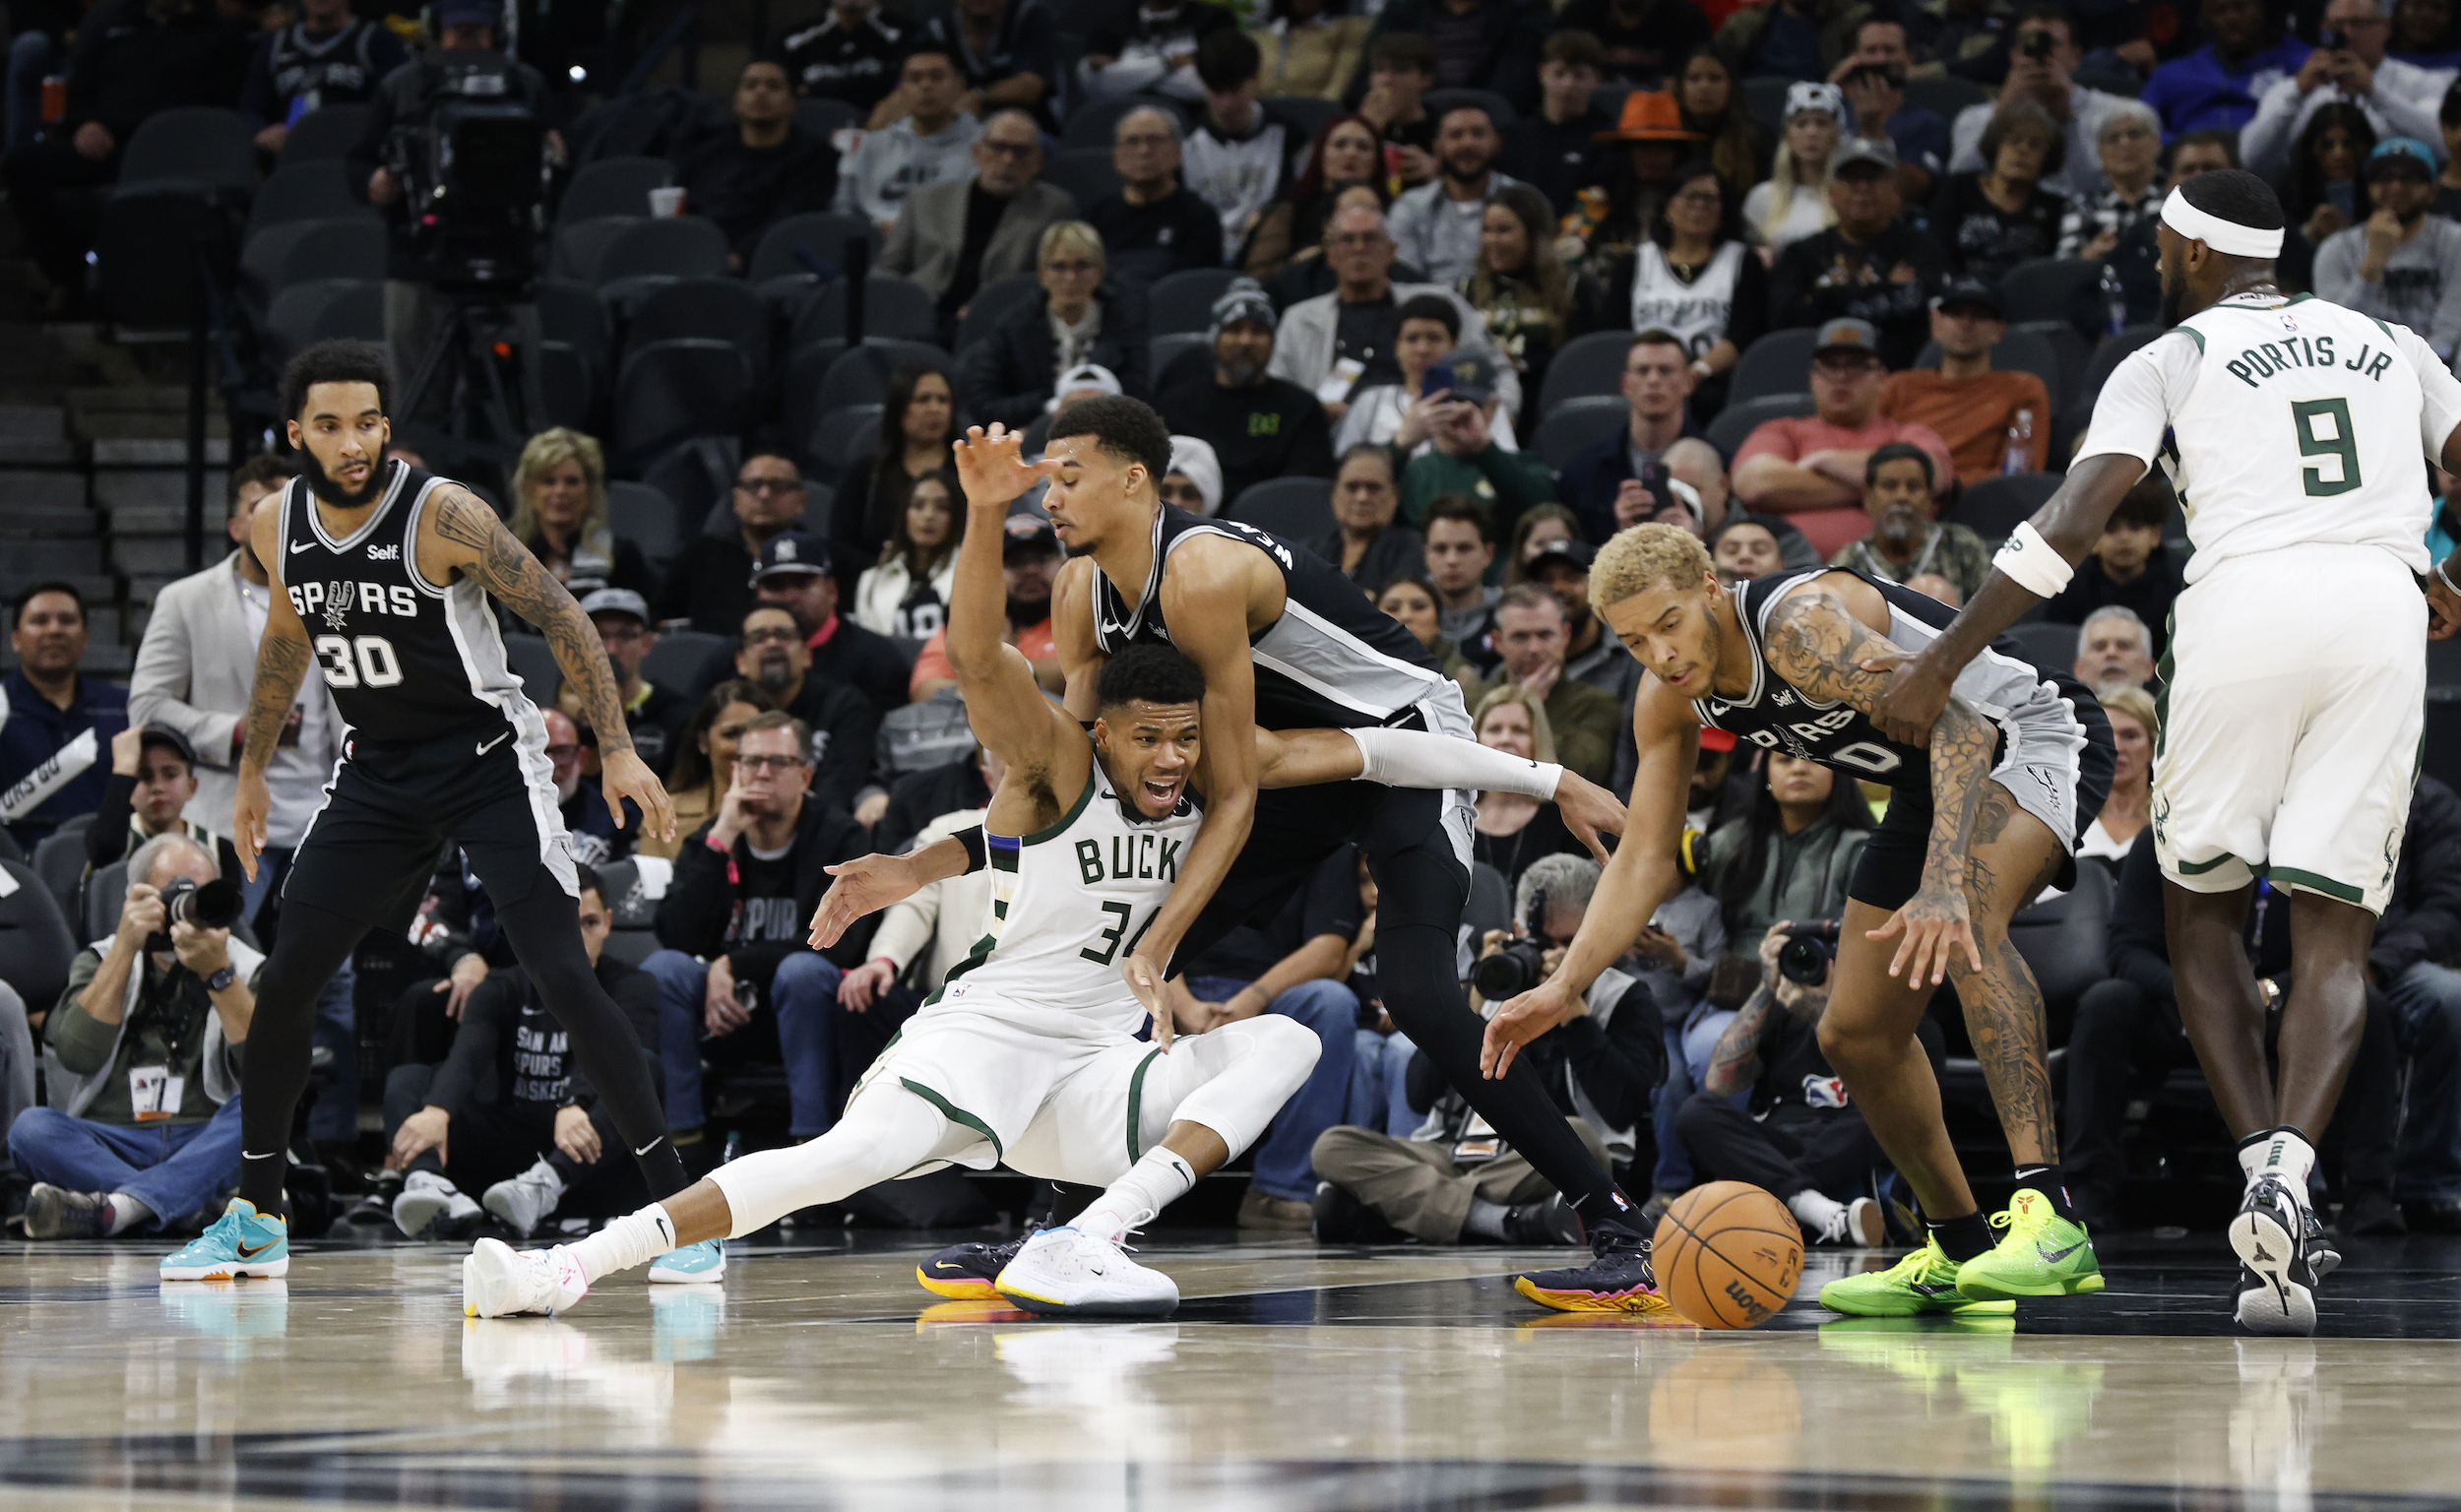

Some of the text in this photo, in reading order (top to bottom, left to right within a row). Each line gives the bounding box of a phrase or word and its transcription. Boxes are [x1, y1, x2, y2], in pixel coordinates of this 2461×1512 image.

[2226, 336, 2393, 389] PORTIS JR
[2289, 396, 2364, 498] 9
[287, 579, 418, 632] SPURS
[313, 633, 405, 689] 30
